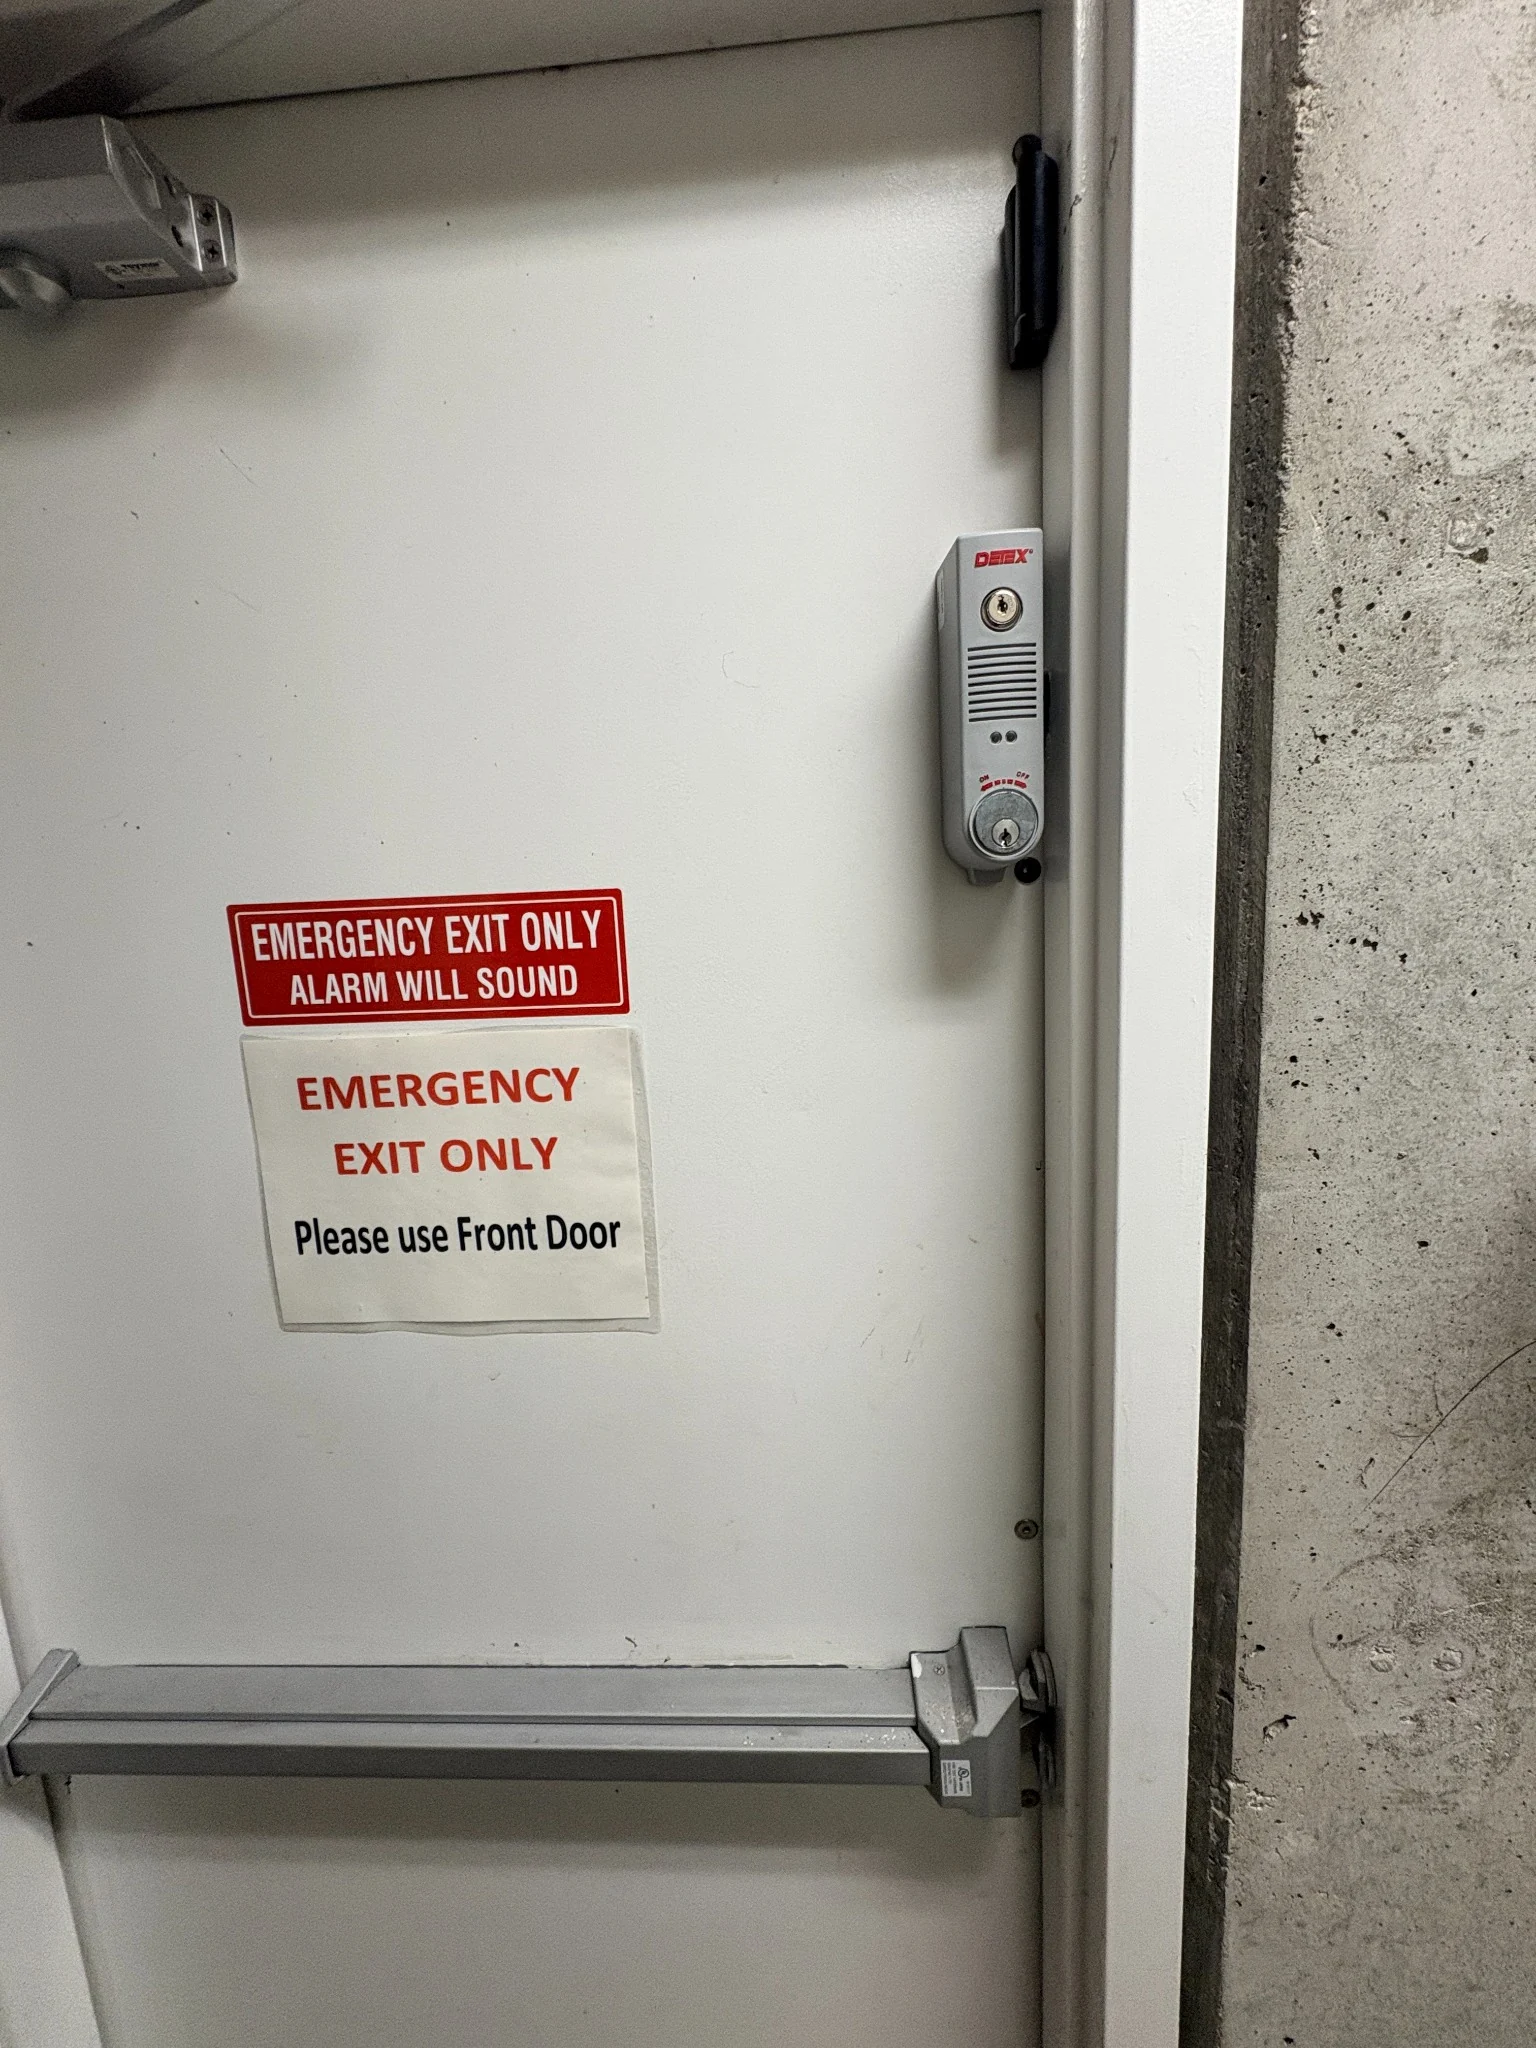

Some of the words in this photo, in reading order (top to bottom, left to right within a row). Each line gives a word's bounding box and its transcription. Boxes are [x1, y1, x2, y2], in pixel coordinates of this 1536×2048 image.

[979, 774, 990, 783] ON
[1016, 771, 1030, 780] OFF
[251, 916, 434, 962] EMERGENCY
[445, 913, 509, 954] EXIT
[520, 909, 602, 952] ONLY
[290, 971, 389, 1006] ALARM
[396, 969, 469, 1002] WILL
[477, 964, 578, 1000] SOUND
[296, 1067, 580, 1111] EMERGENCY
[334, 1141, 426, 1175] EXIT
[440, 1137, 558, 1172] ONLY
[295, 1218, 390, 1256] Please
[399, 1224, 449, 1253] use
[457, 1216, 538, 1252] Front
[546, 1214, 621, 1250] Door
